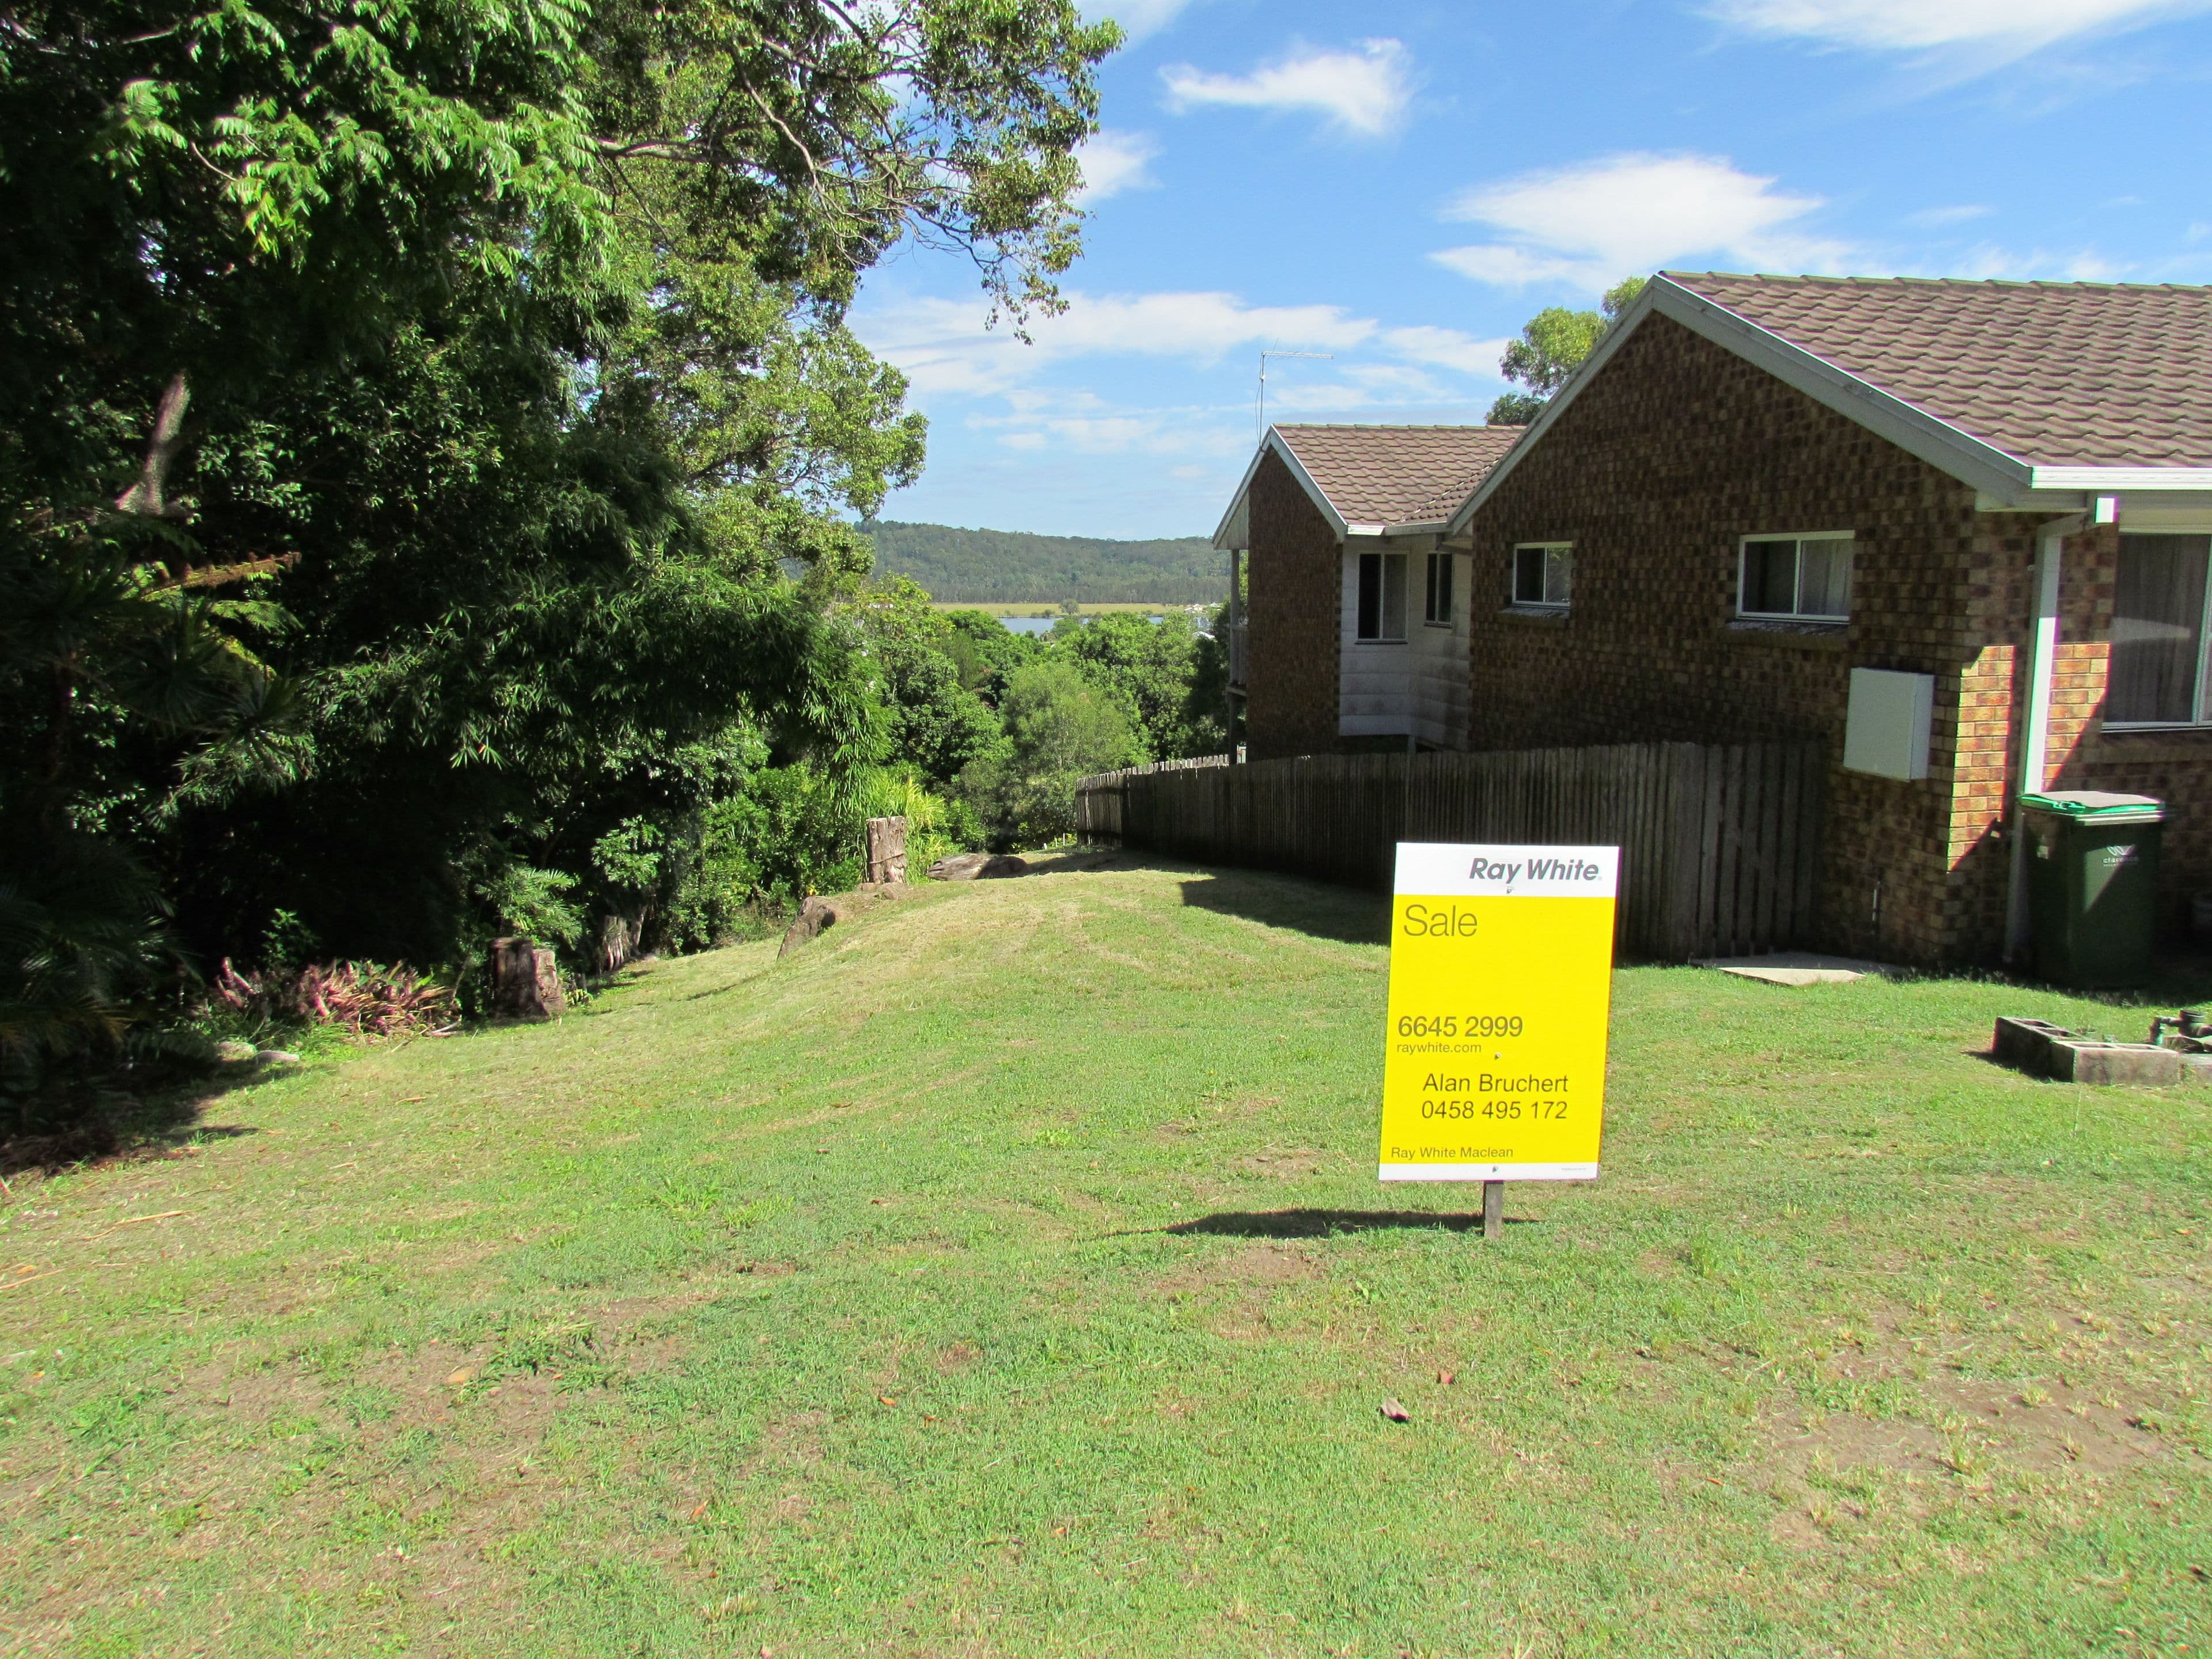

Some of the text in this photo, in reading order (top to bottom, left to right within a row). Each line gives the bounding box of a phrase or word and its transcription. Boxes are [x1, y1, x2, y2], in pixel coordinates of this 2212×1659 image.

[1469, 858, 1599, 884] Ray White
[1403, 904, 1478, 937] Sale
[1398, 1016, 1524, 1037] 6645 2999
[1396, 1041, 1482, 1054] raywhite.com
[1422, 1073, 1569, 1093] Alan Bruchert
[1422, 1101, 1567, 1119] 0458 495 172
[1391, 1147, 1514, 1161] Ray White Maclean
